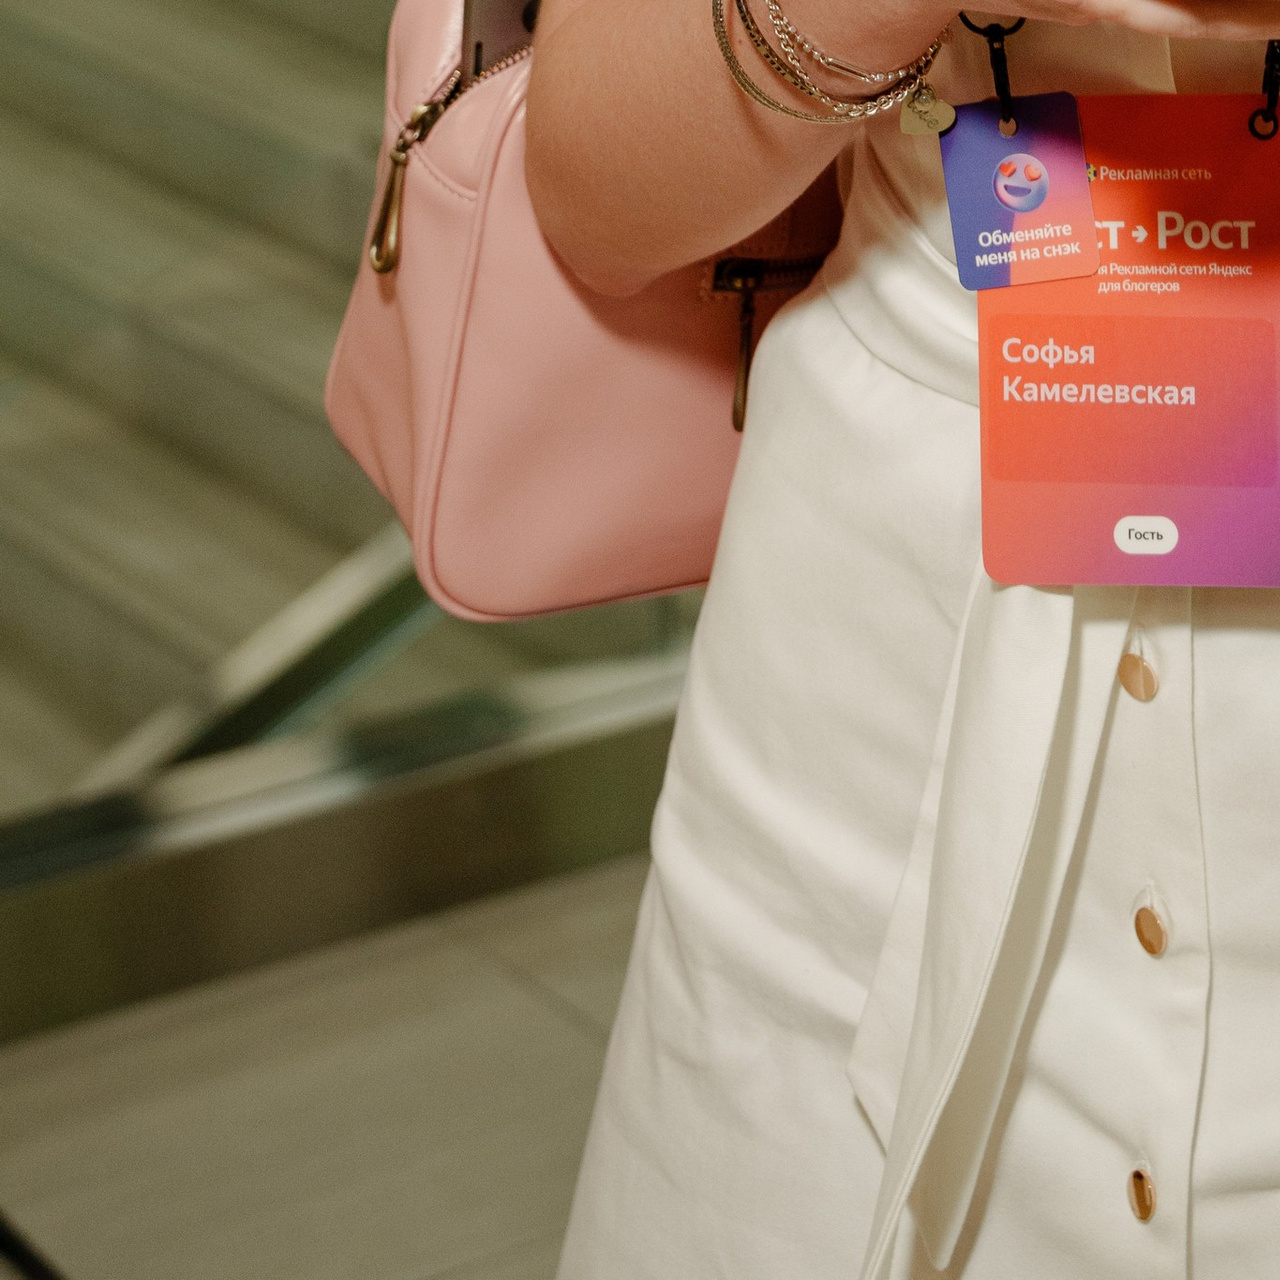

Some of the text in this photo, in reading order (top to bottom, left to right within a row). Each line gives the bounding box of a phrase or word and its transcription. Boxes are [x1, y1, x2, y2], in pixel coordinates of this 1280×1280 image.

[1100, 166, 1212, 182] Рекламная сеть
[978, 223, 1072, 247] Обменяйте
[1157, 211, 1256, 250] Рост
[975, 242, 1082, 268] меня на снэк
[1109, 262, 1178, 276] Рекламной
[1179, 265, 1207, 276] сети
[1208, 263, 1253, 278] Яндекс
[1097, 279, 1181, 295] для блогеров
[1001, 337, 1095, 370] Софья
[1002, 375, 1197, 406] Камелевская
[1128, 528, 1164, 541] Гость
